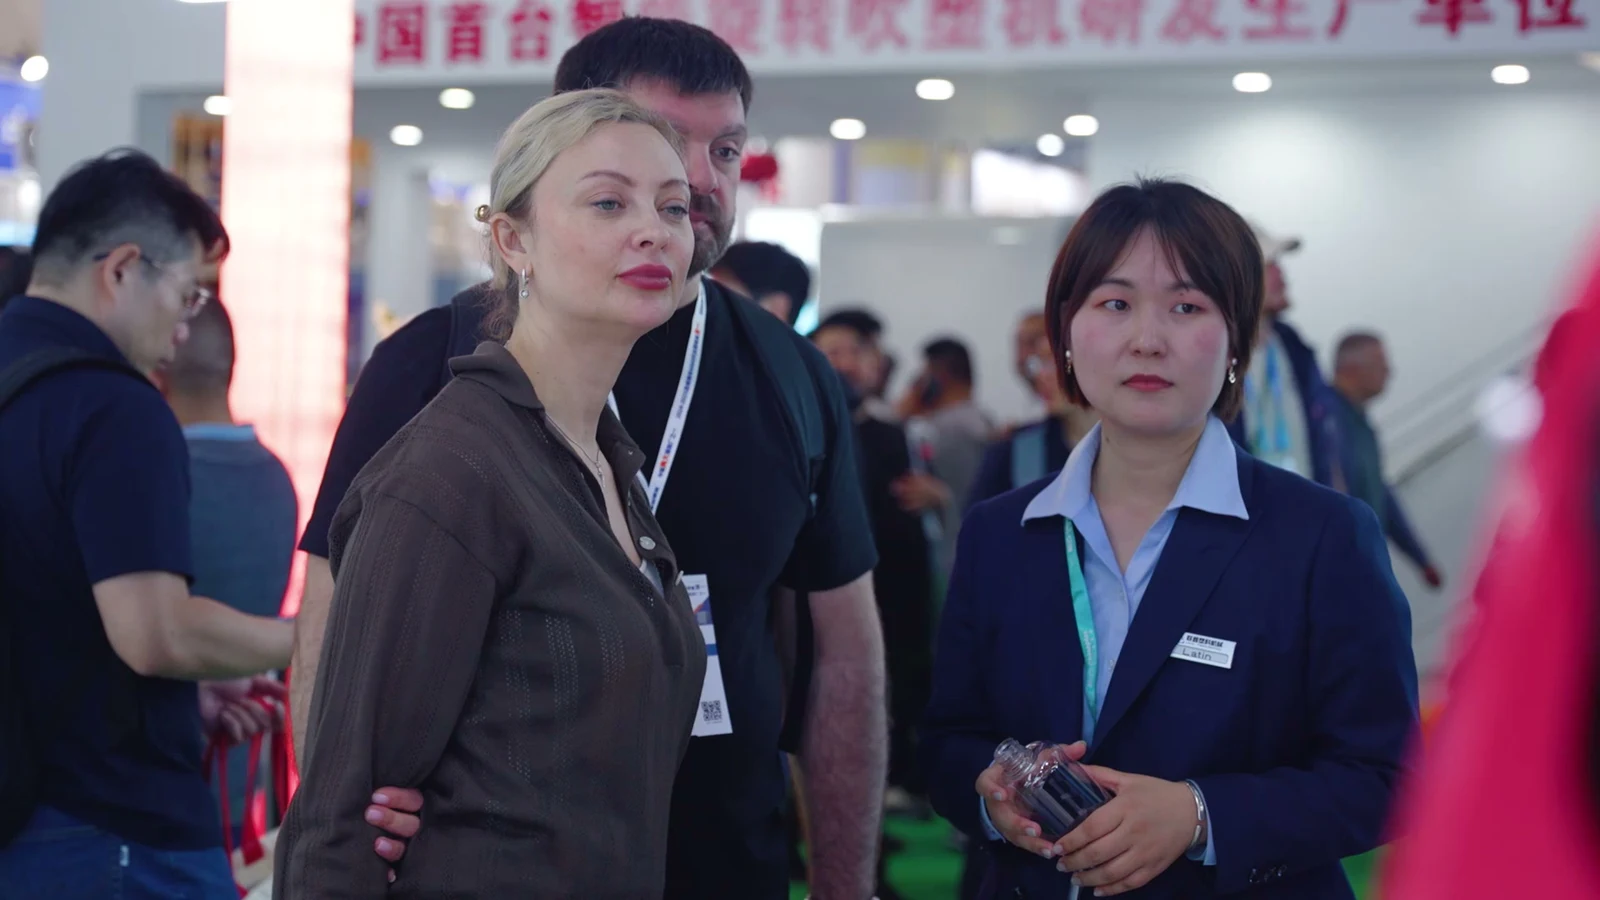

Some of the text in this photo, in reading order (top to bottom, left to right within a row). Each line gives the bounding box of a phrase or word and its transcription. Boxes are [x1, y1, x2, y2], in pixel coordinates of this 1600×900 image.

[353, 0, 1586, 66] 国首台智旋转吹塑机研发生产单位
[1182, 648, 1212, 660] Latin
